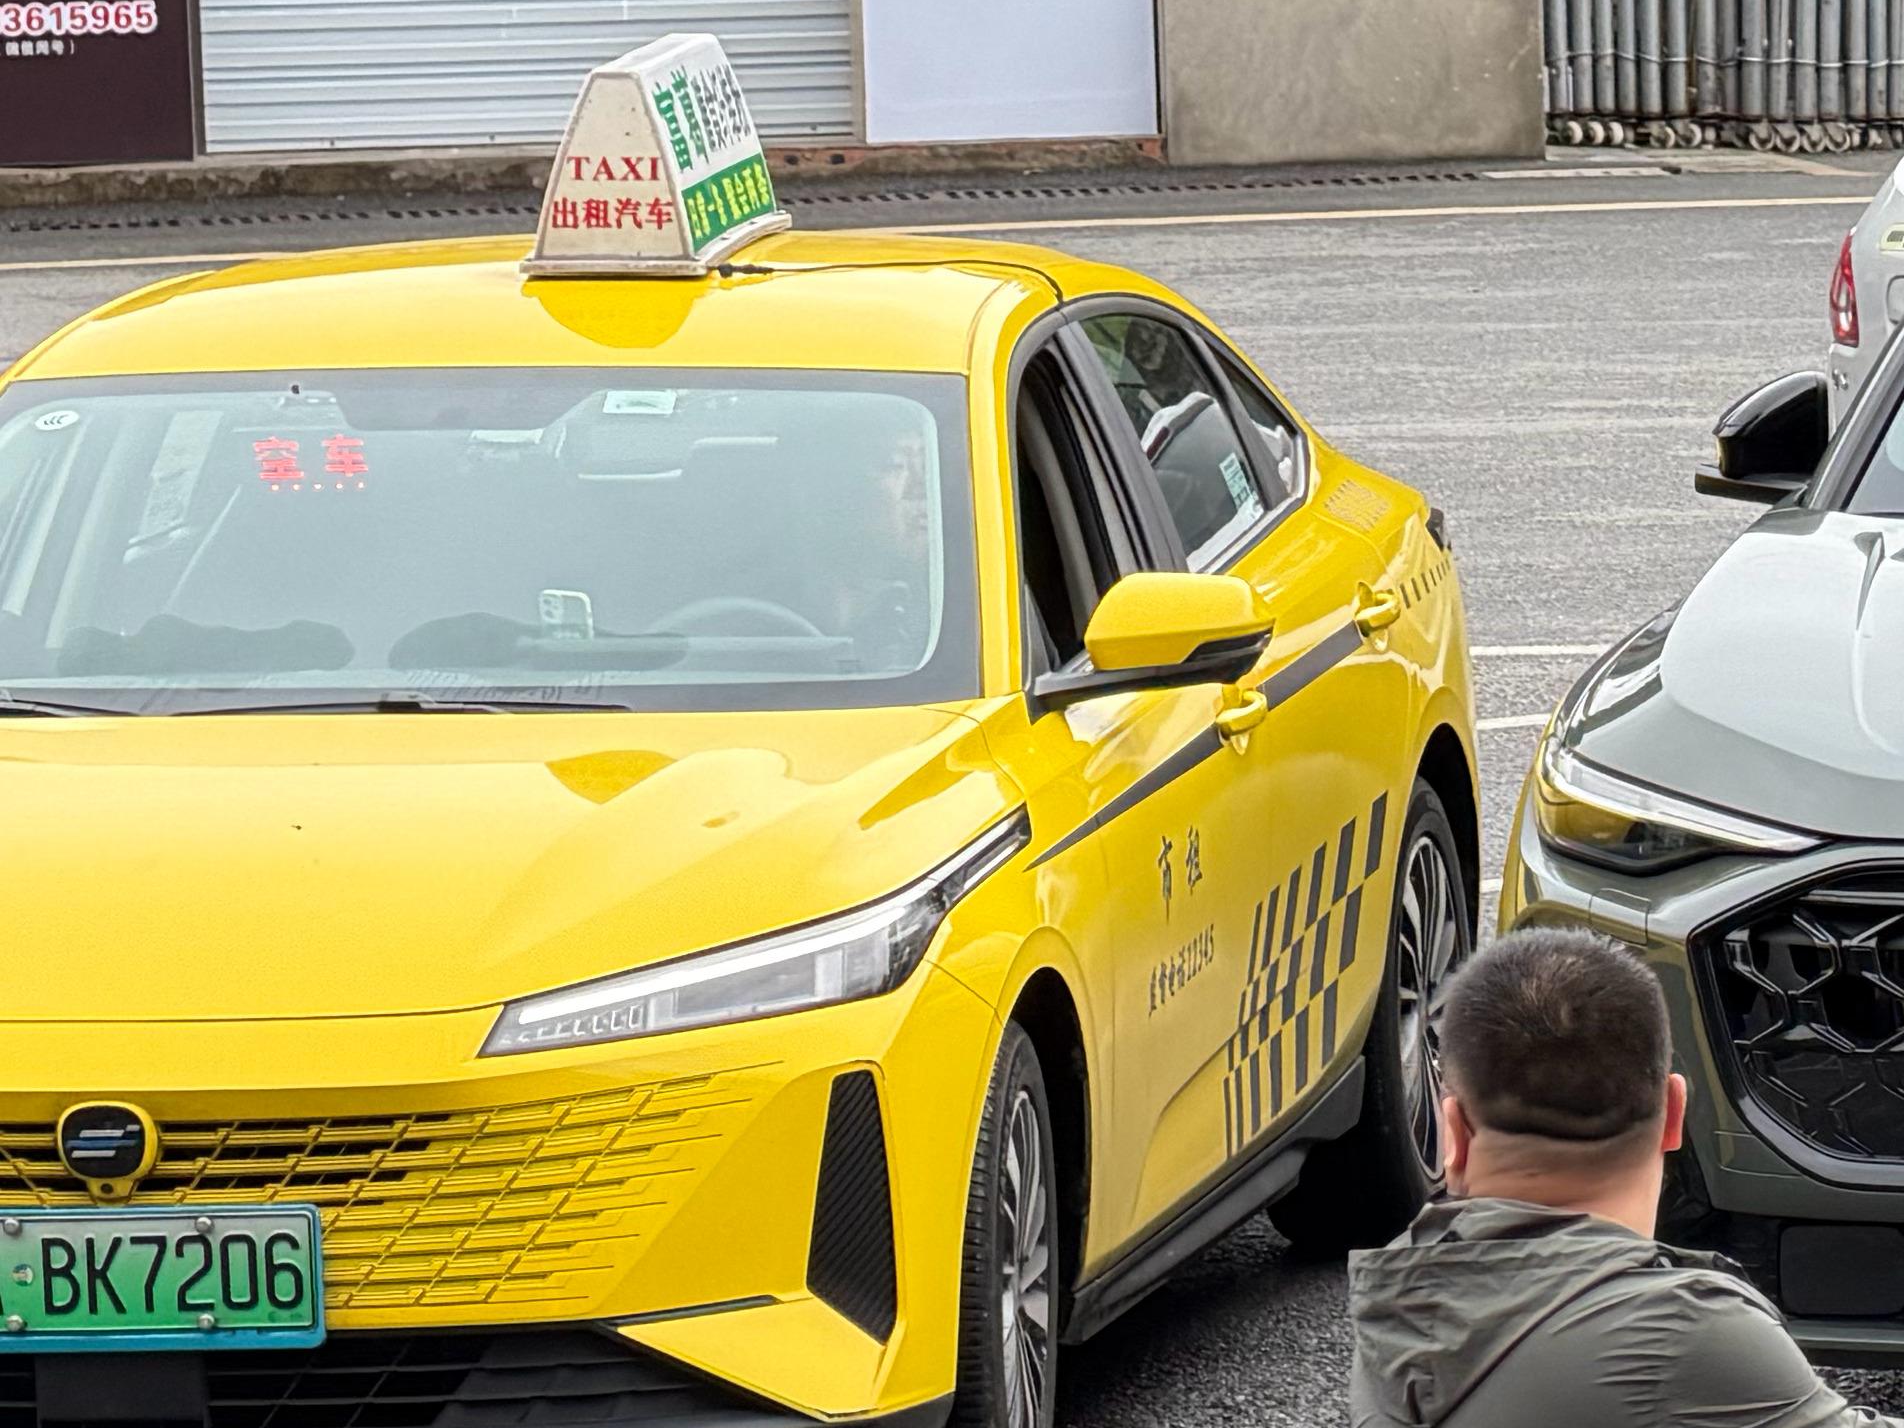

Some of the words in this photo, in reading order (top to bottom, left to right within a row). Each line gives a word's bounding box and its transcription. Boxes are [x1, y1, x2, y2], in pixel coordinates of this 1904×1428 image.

[567, 155, 660, 182] TAXI
[551, 196, 675, 231] 出租汽车
[252, 433, 370, 479] 空车
[41, 1233, 305, 1315] BK7206
